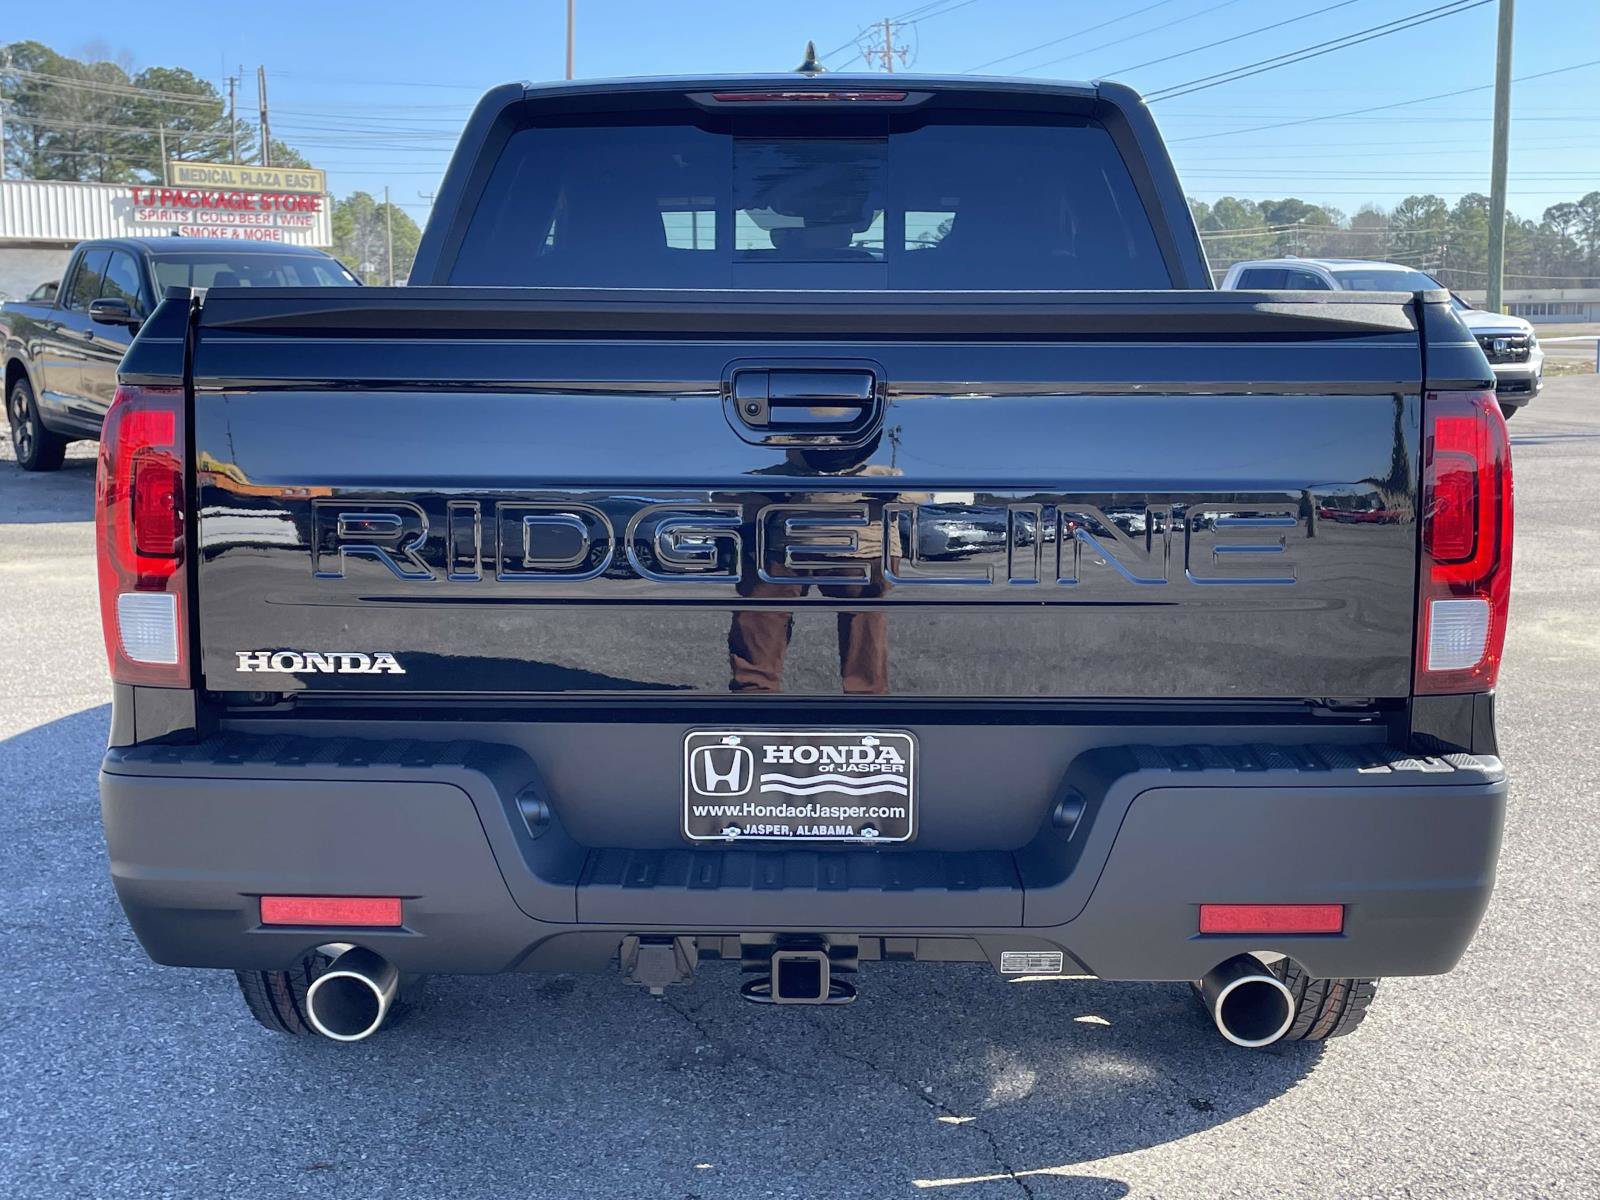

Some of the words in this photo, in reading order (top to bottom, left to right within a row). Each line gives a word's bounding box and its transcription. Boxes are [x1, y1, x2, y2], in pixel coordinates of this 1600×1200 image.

[178, 167, 236, 185] MEDICAL
[240, 171, 281, 187] PLAZA
[285, 174, 317, 189] EAST
[130, 187, 157, 207] TJ
[159, 189, 256, 210] PACKAGE
[259, 193, 322, 213] STORE
[139, 208, 189, 222] SPIRITS
[200, 211, 236, 223] COLD
[239, 213, 270, 225] BEER
[280, 215, 312, 226] WINE
[181, 226, 228, 238] SMOKE
[231, 229, 240, 240] &
[243, 229, 280, 240] MORE
[310, 499, 1299, 585] RIDGELINE
[235, 651, 406, 674] HONDA
[762, 745, 906, 764] HONDA
[818, 763, 834, 772] of
[836, 763, 904, 773] JASPER
[692, 803, 906, 820] www.HondaofJasper.com
[743, 824, 793, 837] JASPER,
[796, 825, 854, 836] ALABAMA
